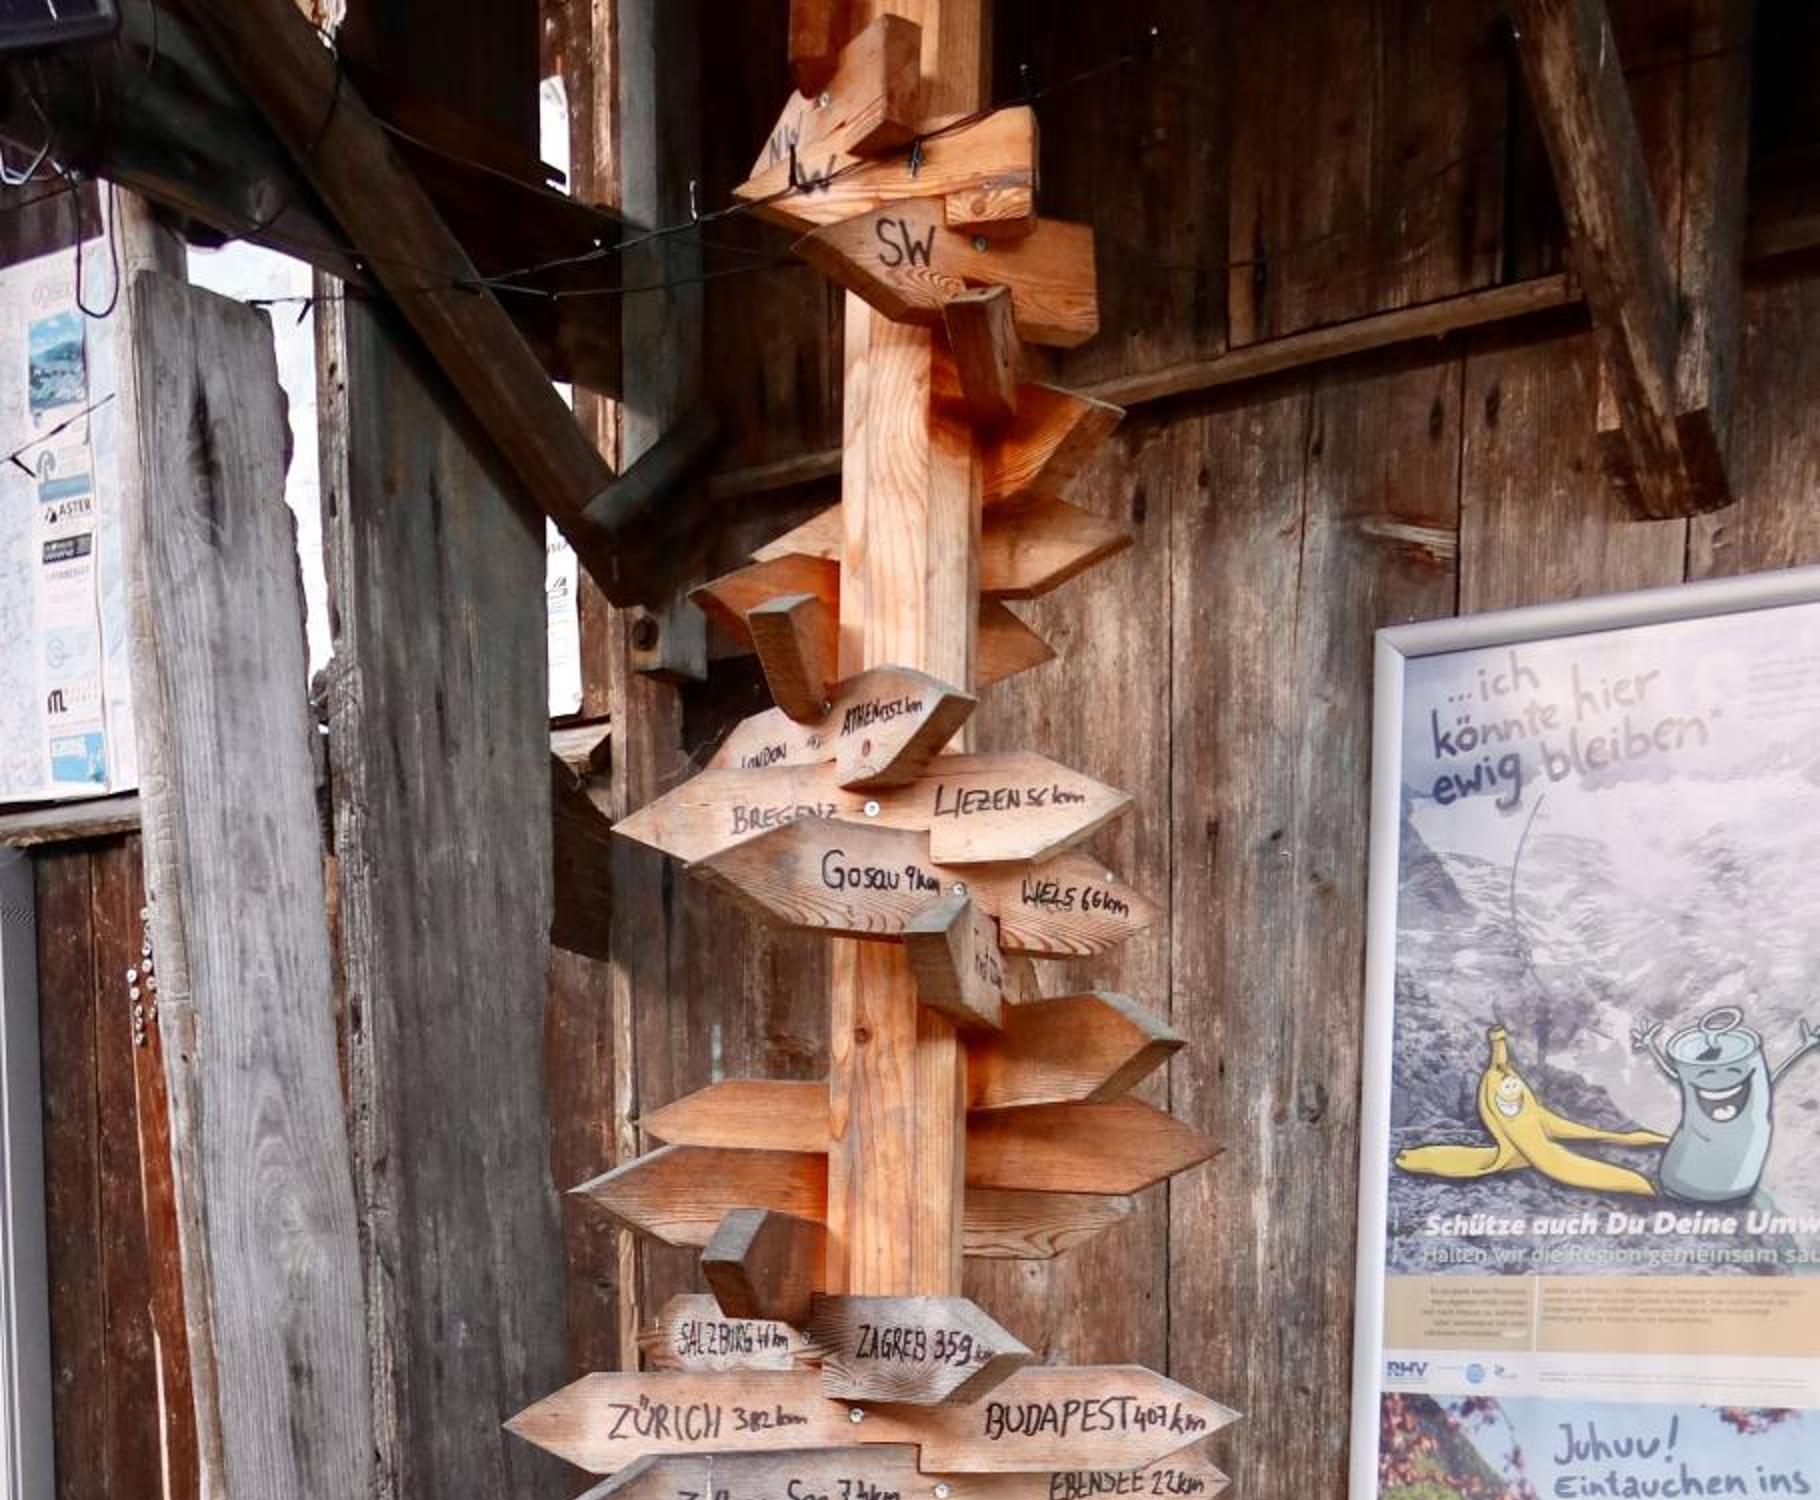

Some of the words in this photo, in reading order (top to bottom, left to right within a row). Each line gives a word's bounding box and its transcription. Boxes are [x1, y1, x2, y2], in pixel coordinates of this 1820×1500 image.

[877, 218, 936, 268] SW
[1432, 702, 1557, 758] könnte
[1571, 663, 1660, 721] hier
[934, 784, 1021, 818] LIEZEN
[1432, 752, 1521, 812] ewig
[821, 849, 900, 890] Gosau
[1424, 1213, 1526, 1237] Schütze
[1533, 1212, 1598, 1236] auch
[1605, 1211, 1647, 1235] Du
[1653, 1210, 1738, 1235] Deine
[1424, 1246, 1488, 1265] Halten
[1495, 1247, 1529, 1265] wir
[1531, 1246, 1566, 1265] die
[1569, 1246, 1642, 1267] Region
[1649, 1247, 1778, 1266] gemeinsam
[856, 1324, 926, 1362] ZAGREB
[608, 1394, 721, 1441] ZÜRICH
[984, 1396, 1137, 1440] BUDAPEST
[1554, 1463, 1747, 1499] Eintauchen
[1756, 1465, 1812, 1495] ins
